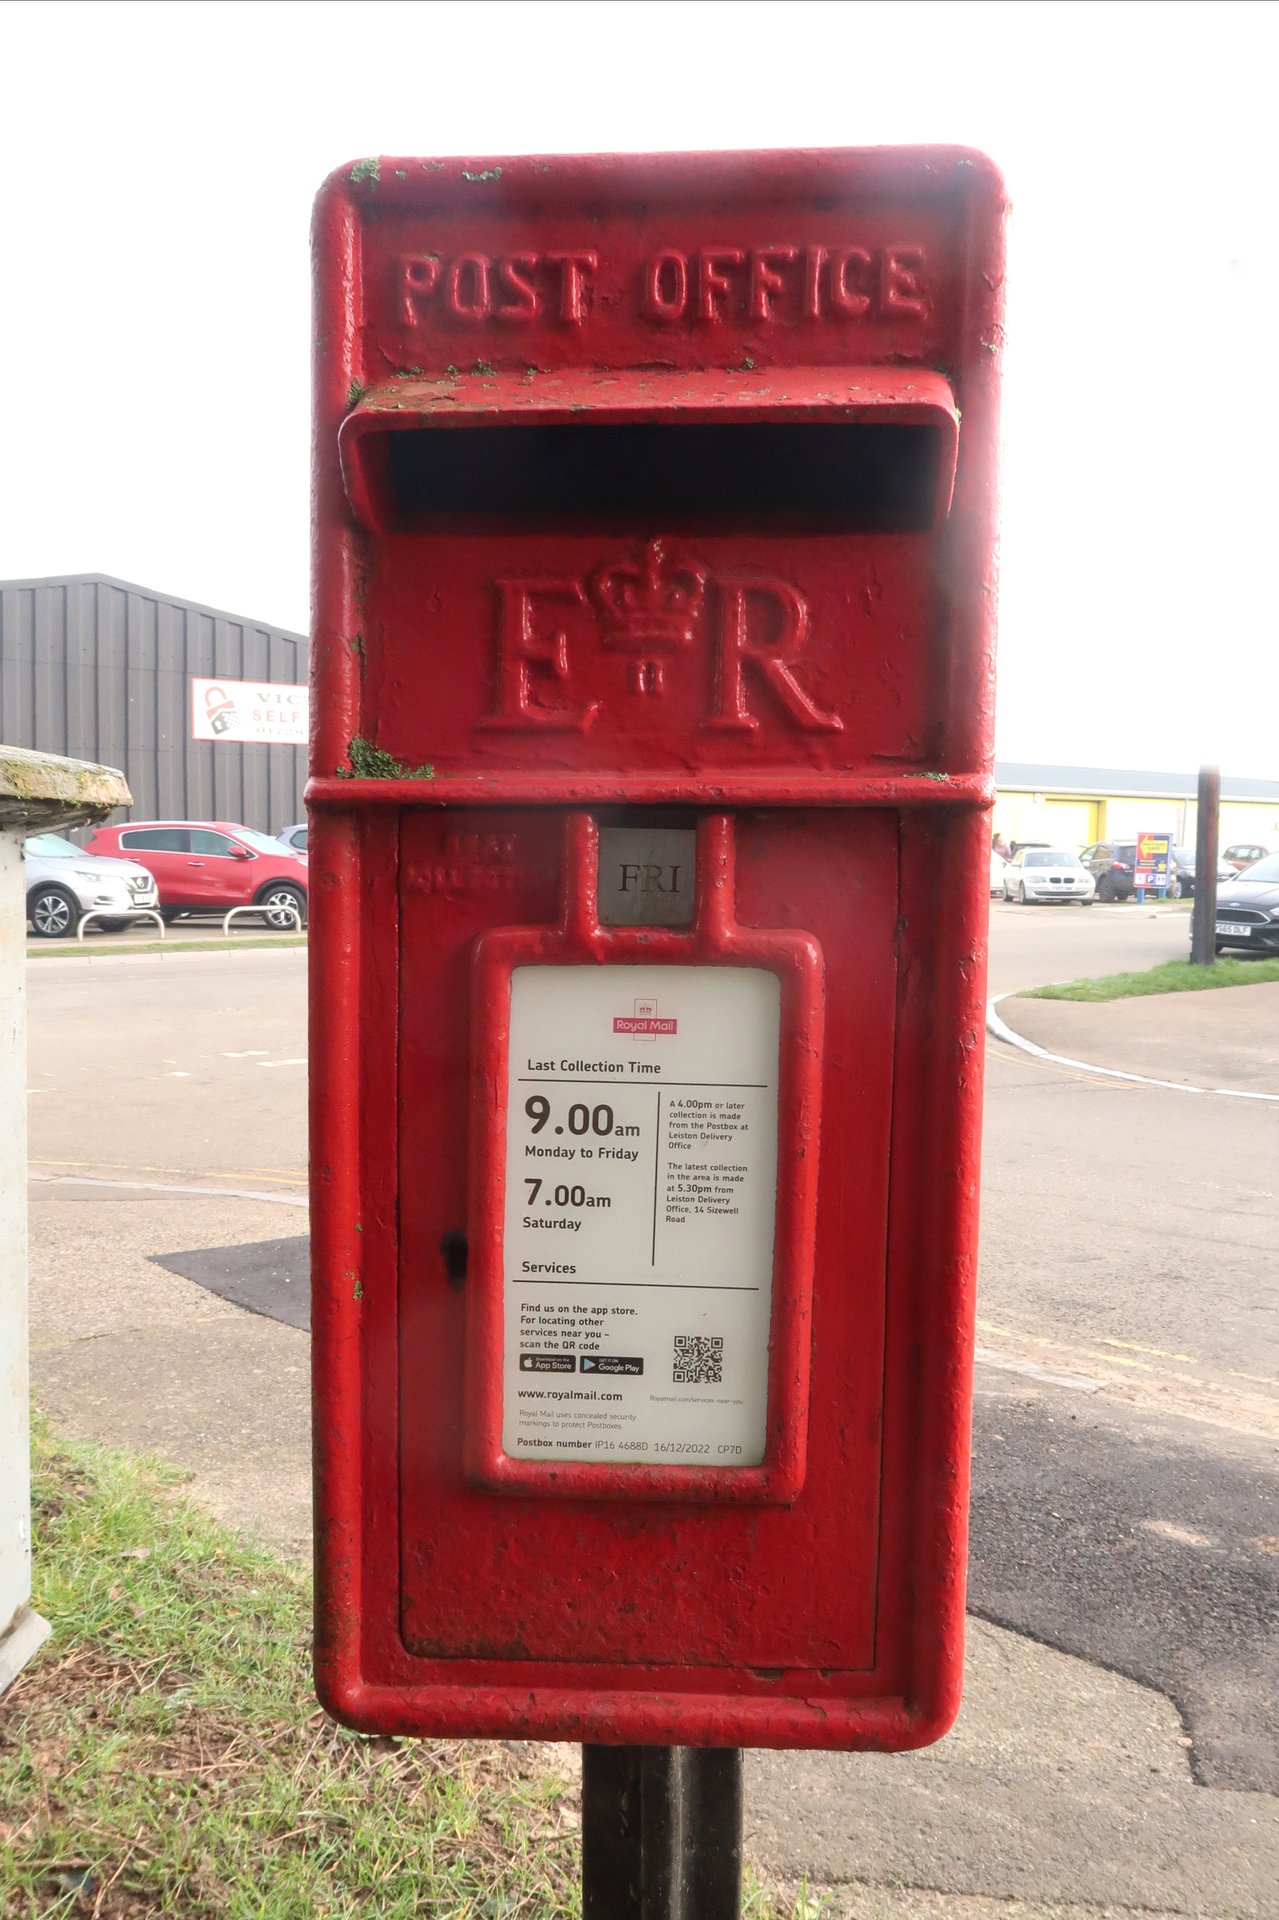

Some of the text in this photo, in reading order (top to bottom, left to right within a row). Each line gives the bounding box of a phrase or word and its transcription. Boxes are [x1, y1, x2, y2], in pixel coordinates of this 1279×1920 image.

[402, 243, 928, 328] POST OFFICE
[478, 574, 845, 734] E R
[252, 709, 300, 723] SELF
[617, 863, 682, 893] FRI
[616, 1019, 674, 1032] Royal Mail
[527, 1058, 662, 1074] Last Collection Time
[669, 1100, 676, 1108] A
[677, 1099, 712, 1109] 4.00pm
[525, 1095, 640, 1137] 9.00am
[669, 1111, 707, 1119] collection
[669, 1121, 688, 1129] from
[706, 1122, 738, 1130] Postbox
[668, 1131, 733, 1142] Leiston Delivery
[668, 1142, 692, 1150] Office
[525, 1145, 639, 1162] Monday to Friday
[667, 1162, 748, 1172] The latest collection
[524, 1178, 611, 1207] 7.00am
[677, 1184, 712, 1194] 5.30pm
[714, 1186, 734, 1194] from
[666, 1195, 730, 1205] Leiston Delivery
[666, 1205, 691, 1214] Office,
[707, 1206, 739, 1215] Sizewell
[522, 1216, 582, 1232] Saturday
[665, 1215, 686, 1223] Road
[521, 1261, 577, 1275] Services
[521, 1303, 541, 1312] Find
[544, 1305, 555, 1313] us
[572, 1305, 588, 1314] the
[591, 1307, 608, 1316] app
[611, 1307, 638, 1315] store.
[520, 1316, 604, 1327] For locating other
[520, 1328, 558, 1337] services
[584, 1331, 602, 1340] you
[544, 1340, 559, 1349] the
[562, 1341, 576, 1350] QR
[578, 1342, 600, 1350] code
[535, 1362, 572, 1370] App Store
[598, 1363, 640, 1373] Google Play
[518, 1389, 623, 1402] www.royalmail.com
[519, 1409, 538, 1419] Royal
[540, 1410, 555, 1418] Mail
[609, 1413, 637, 1422] security
[519, 1420, 551, 1428] markings
[561, 1421, 585, 1429] protect
[517, 1437, 743, 1455] Postbox number IP16 4688D 16/12/2022 CP7D
